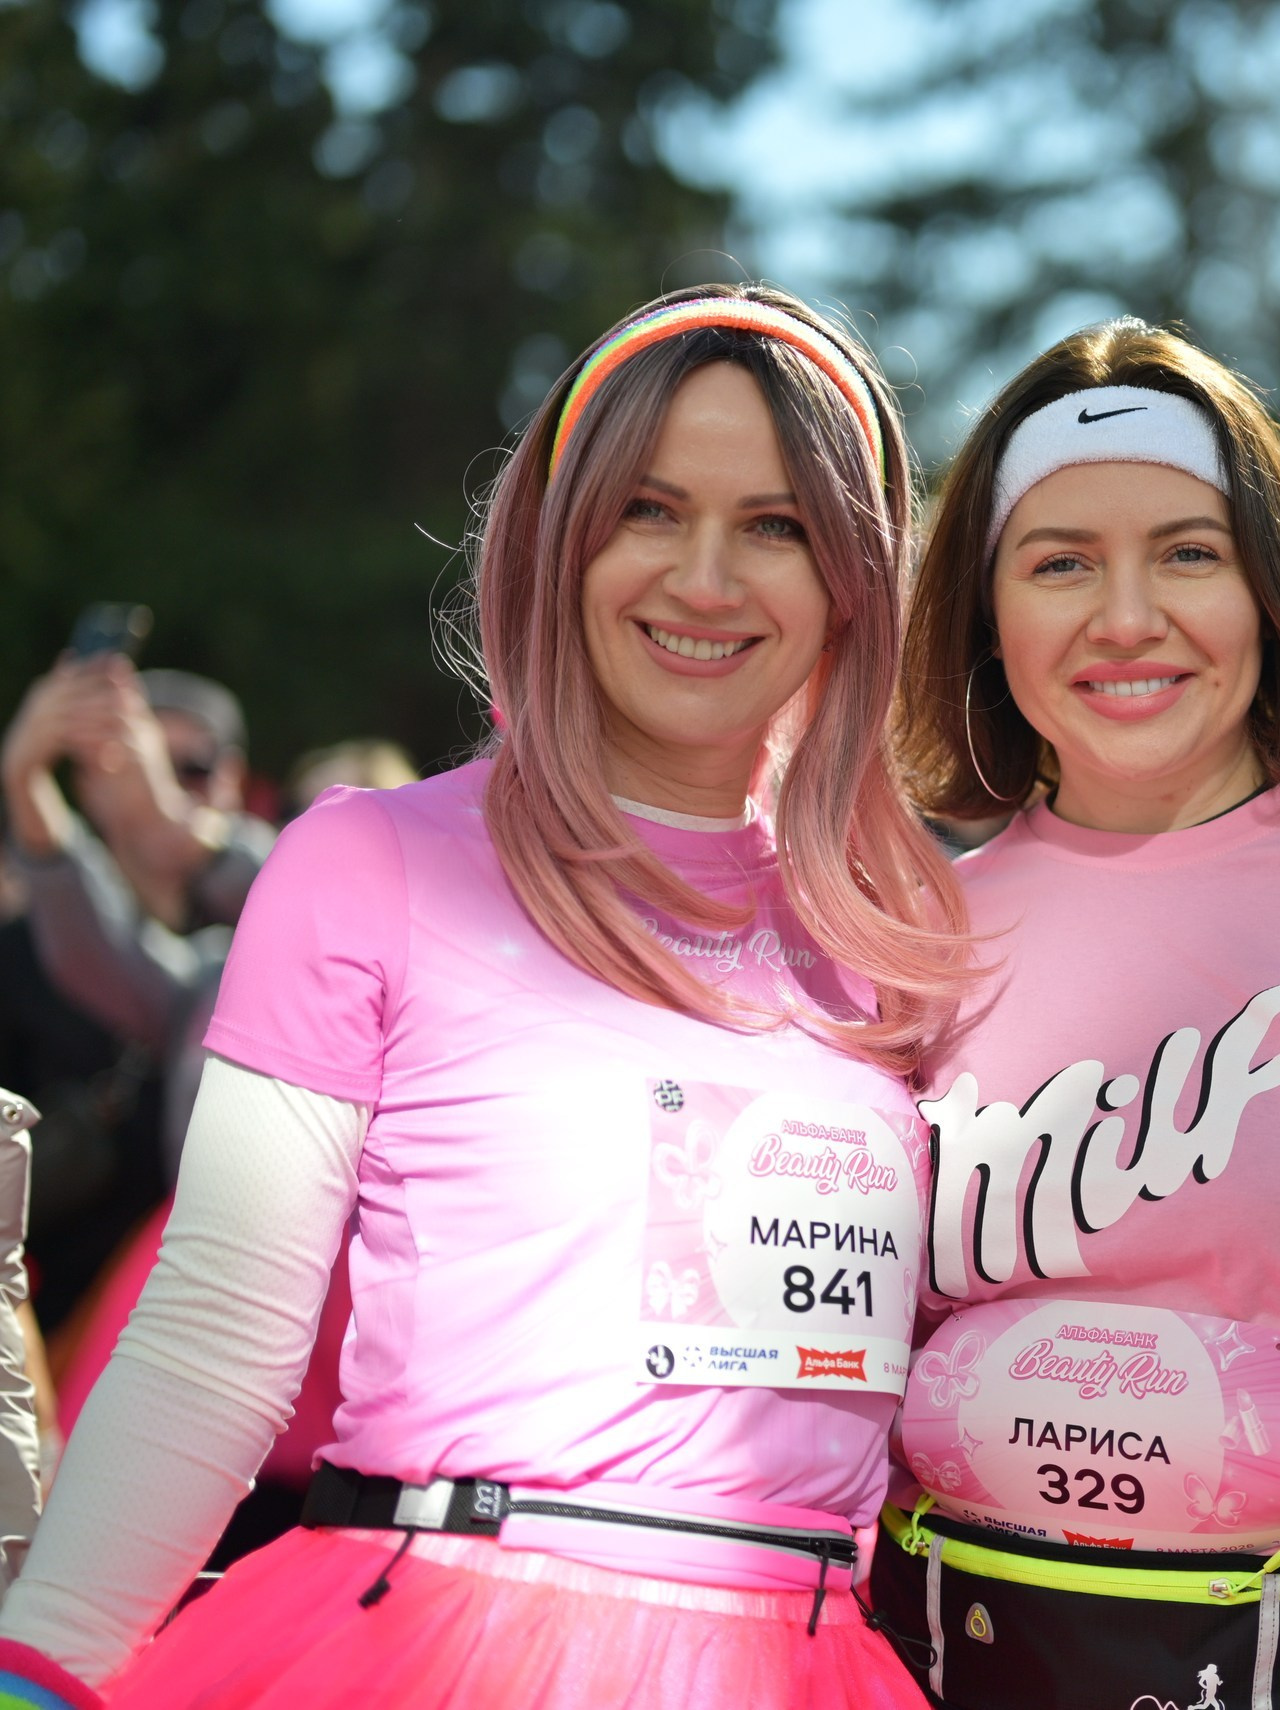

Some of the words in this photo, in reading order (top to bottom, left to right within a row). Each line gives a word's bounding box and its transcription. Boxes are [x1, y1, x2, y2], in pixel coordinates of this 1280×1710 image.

[749, 928, 817, 973] Run
[781, 1120, 867, 1146] АЛЬФА-БАНК
[748, 1134, 842, 1195] Beauty
[843, 1147, 898, 1195] Run
[750, 1216, 899, 1260] МАРИНА
[782, 1264, 873, 1317] 841
[710, 1346, 778, 1359] ВЫСШАЯ
[1056, 1325, 1158, 1349] АЛЬФА-БАНК
[708, 1360, 747, 1371] ЛИГА
[836, 1358, 859, 1369] Банк
[883, 1362, 890, 1373] 8
[1009, 1339, 1118, 1399] Beauty
[1117, 1351, 1189, 1400] Run
[1008, 1417, 1171, 1465] ЛАРИСА
[1036, 1463, 1145, 1515] 329
[984, 1516, 1047, 1537] ВЫСШАЯ
